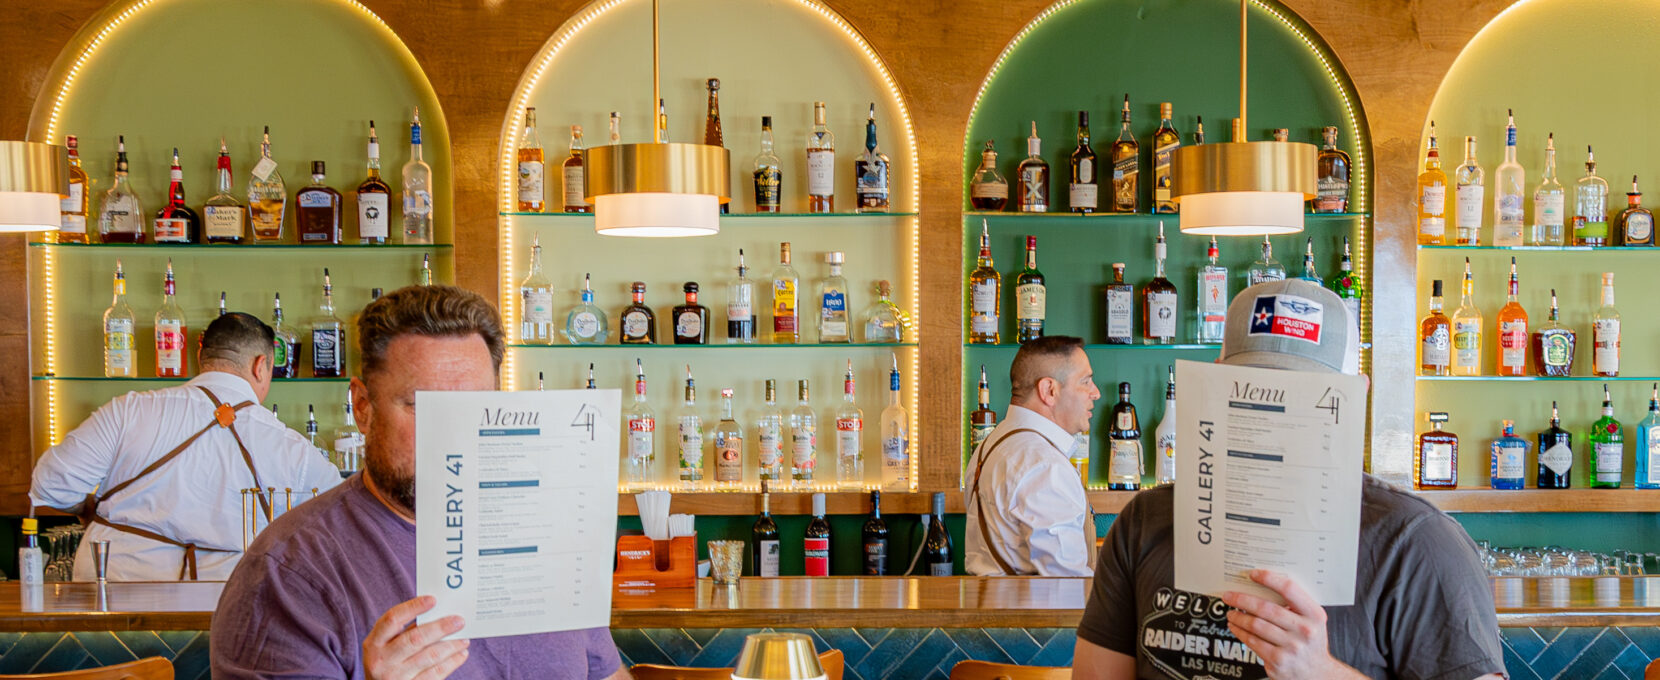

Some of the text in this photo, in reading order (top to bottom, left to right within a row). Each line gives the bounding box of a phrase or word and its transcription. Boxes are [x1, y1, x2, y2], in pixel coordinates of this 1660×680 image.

[1020, 286, 1045, 294] JAMESON
[1277, 317, 1315, 332] HOUSTON
[1284, 326, 1306, 338] WING
[1230, 381, 1286, 403] Menu
[480, 407, 541, 427] Menu
[1198, 420, 1214, 545] GALLERY 41
[446, 454, 464, 590] GALLERY 41
[1156, 592, 1246, 616] WELC
[1174, 620, 1186, 630] TO
[1145, 627, 1262, 666] RAIDER NATI
[1181, 656, 1244, 678] LAS VEGAS
